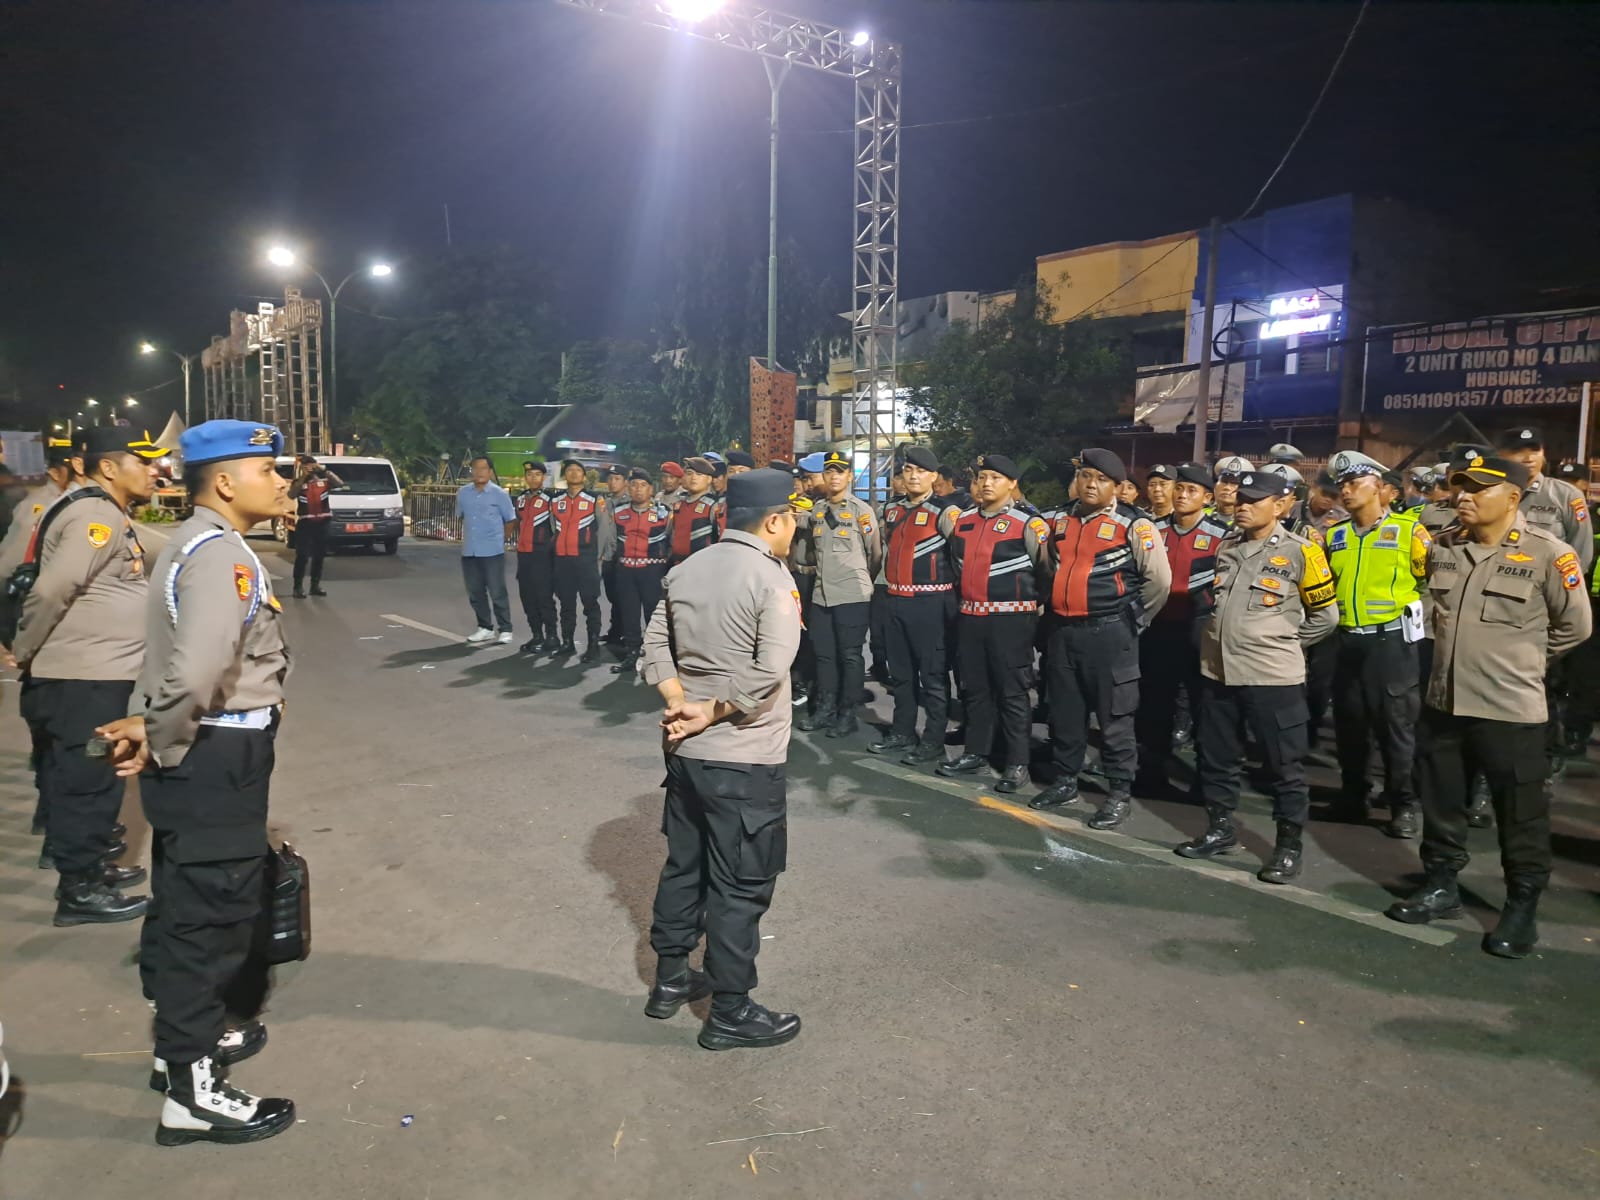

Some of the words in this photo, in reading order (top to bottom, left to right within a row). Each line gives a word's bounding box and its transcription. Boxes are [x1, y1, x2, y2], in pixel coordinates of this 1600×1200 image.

[1392, 320, 1509, 354] DIJUAL
[1405, 356, 1415, 373] 2
[1419, 352, 1459, 372] UNIT
[1461, 350, 1509, 370] RUKO
[1513, 348, 1539, 368] NO
[1542, 347, 1554, 365] 4
[1466, 371, 1541, 388] HUBUNGI:
[1384, 390, 1487, 410] 085141091357
[1491, 388, 1498, 405] /
[1261, 565, 1291, 578] POLRI
[1496, 564, 1534, 578] POLRI
